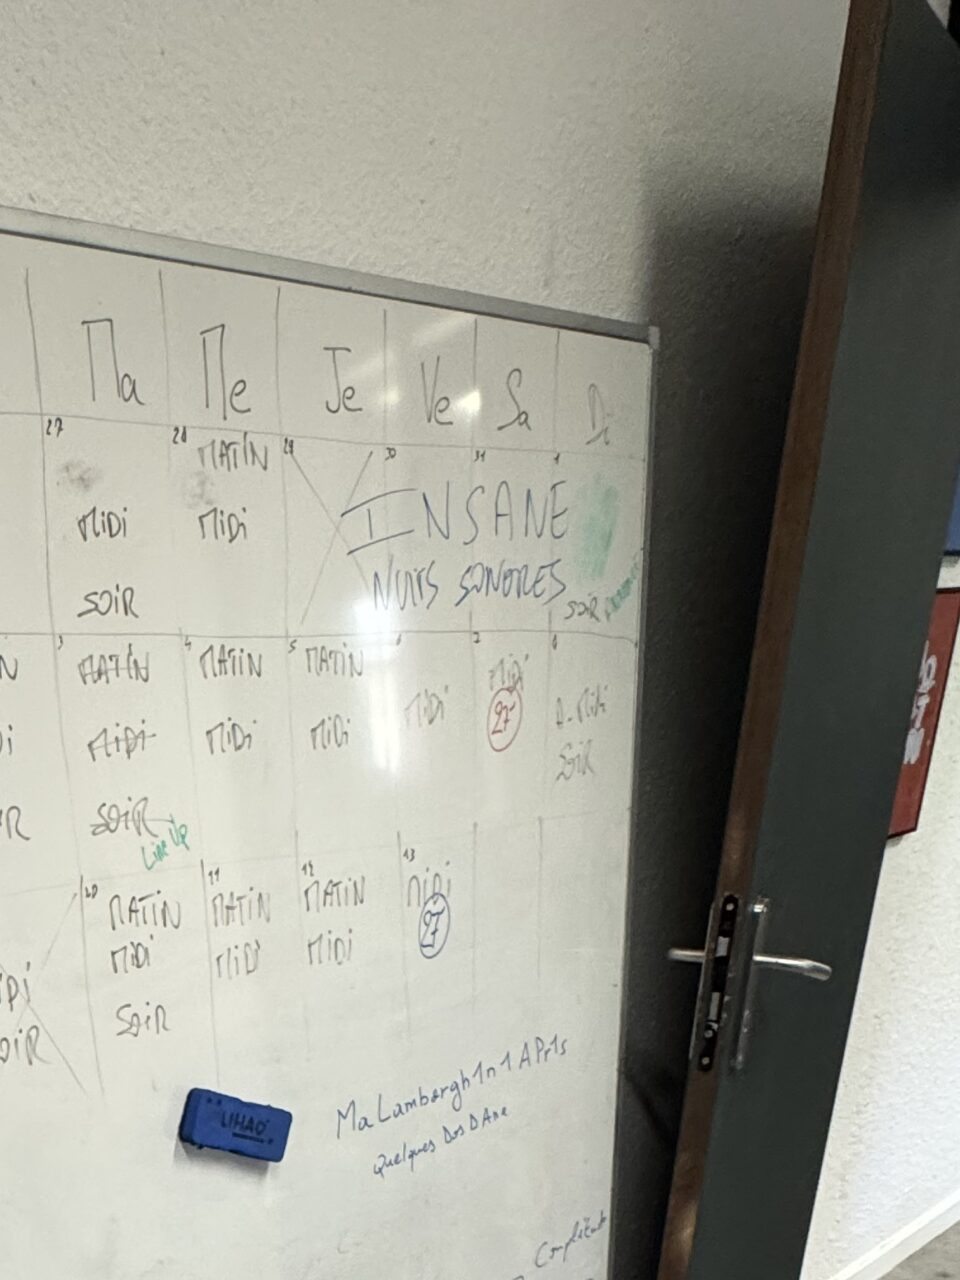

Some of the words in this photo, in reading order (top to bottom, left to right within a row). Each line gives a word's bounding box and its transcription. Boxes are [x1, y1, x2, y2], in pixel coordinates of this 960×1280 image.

[323, 346, 363, 414] Je
[420, 355, 454, 426] Ve
[497, 368, 531, 431] Sa
[45, 418, 64, 437] 27
[340, 480, 570, 556] INSANE
